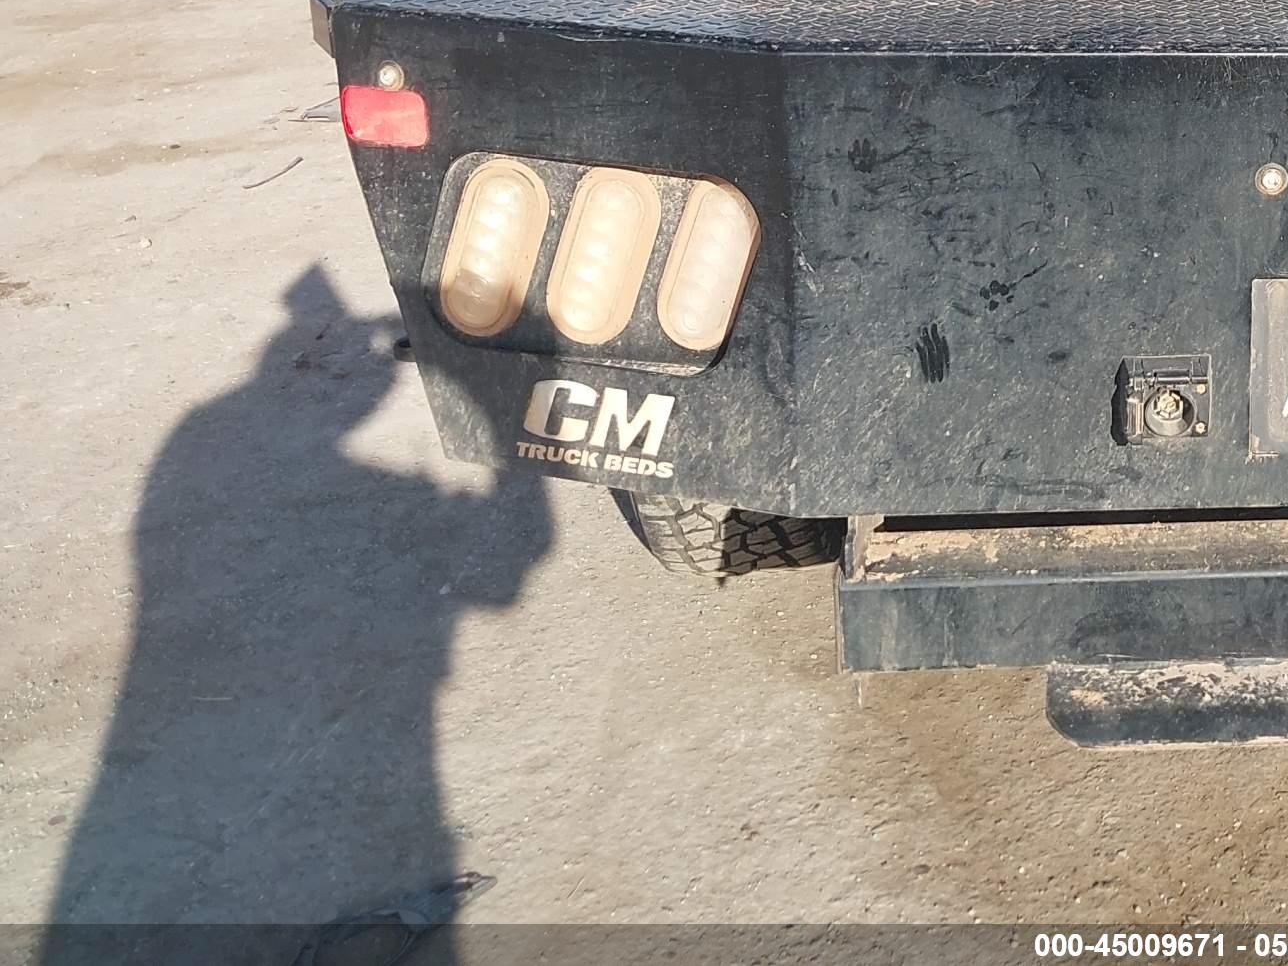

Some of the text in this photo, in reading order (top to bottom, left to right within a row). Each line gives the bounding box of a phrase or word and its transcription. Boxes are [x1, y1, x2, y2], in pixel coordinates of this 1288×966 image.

[523, 379, 676, 456] CM
[516, 441, 675, 479] TRUCK BEDS
